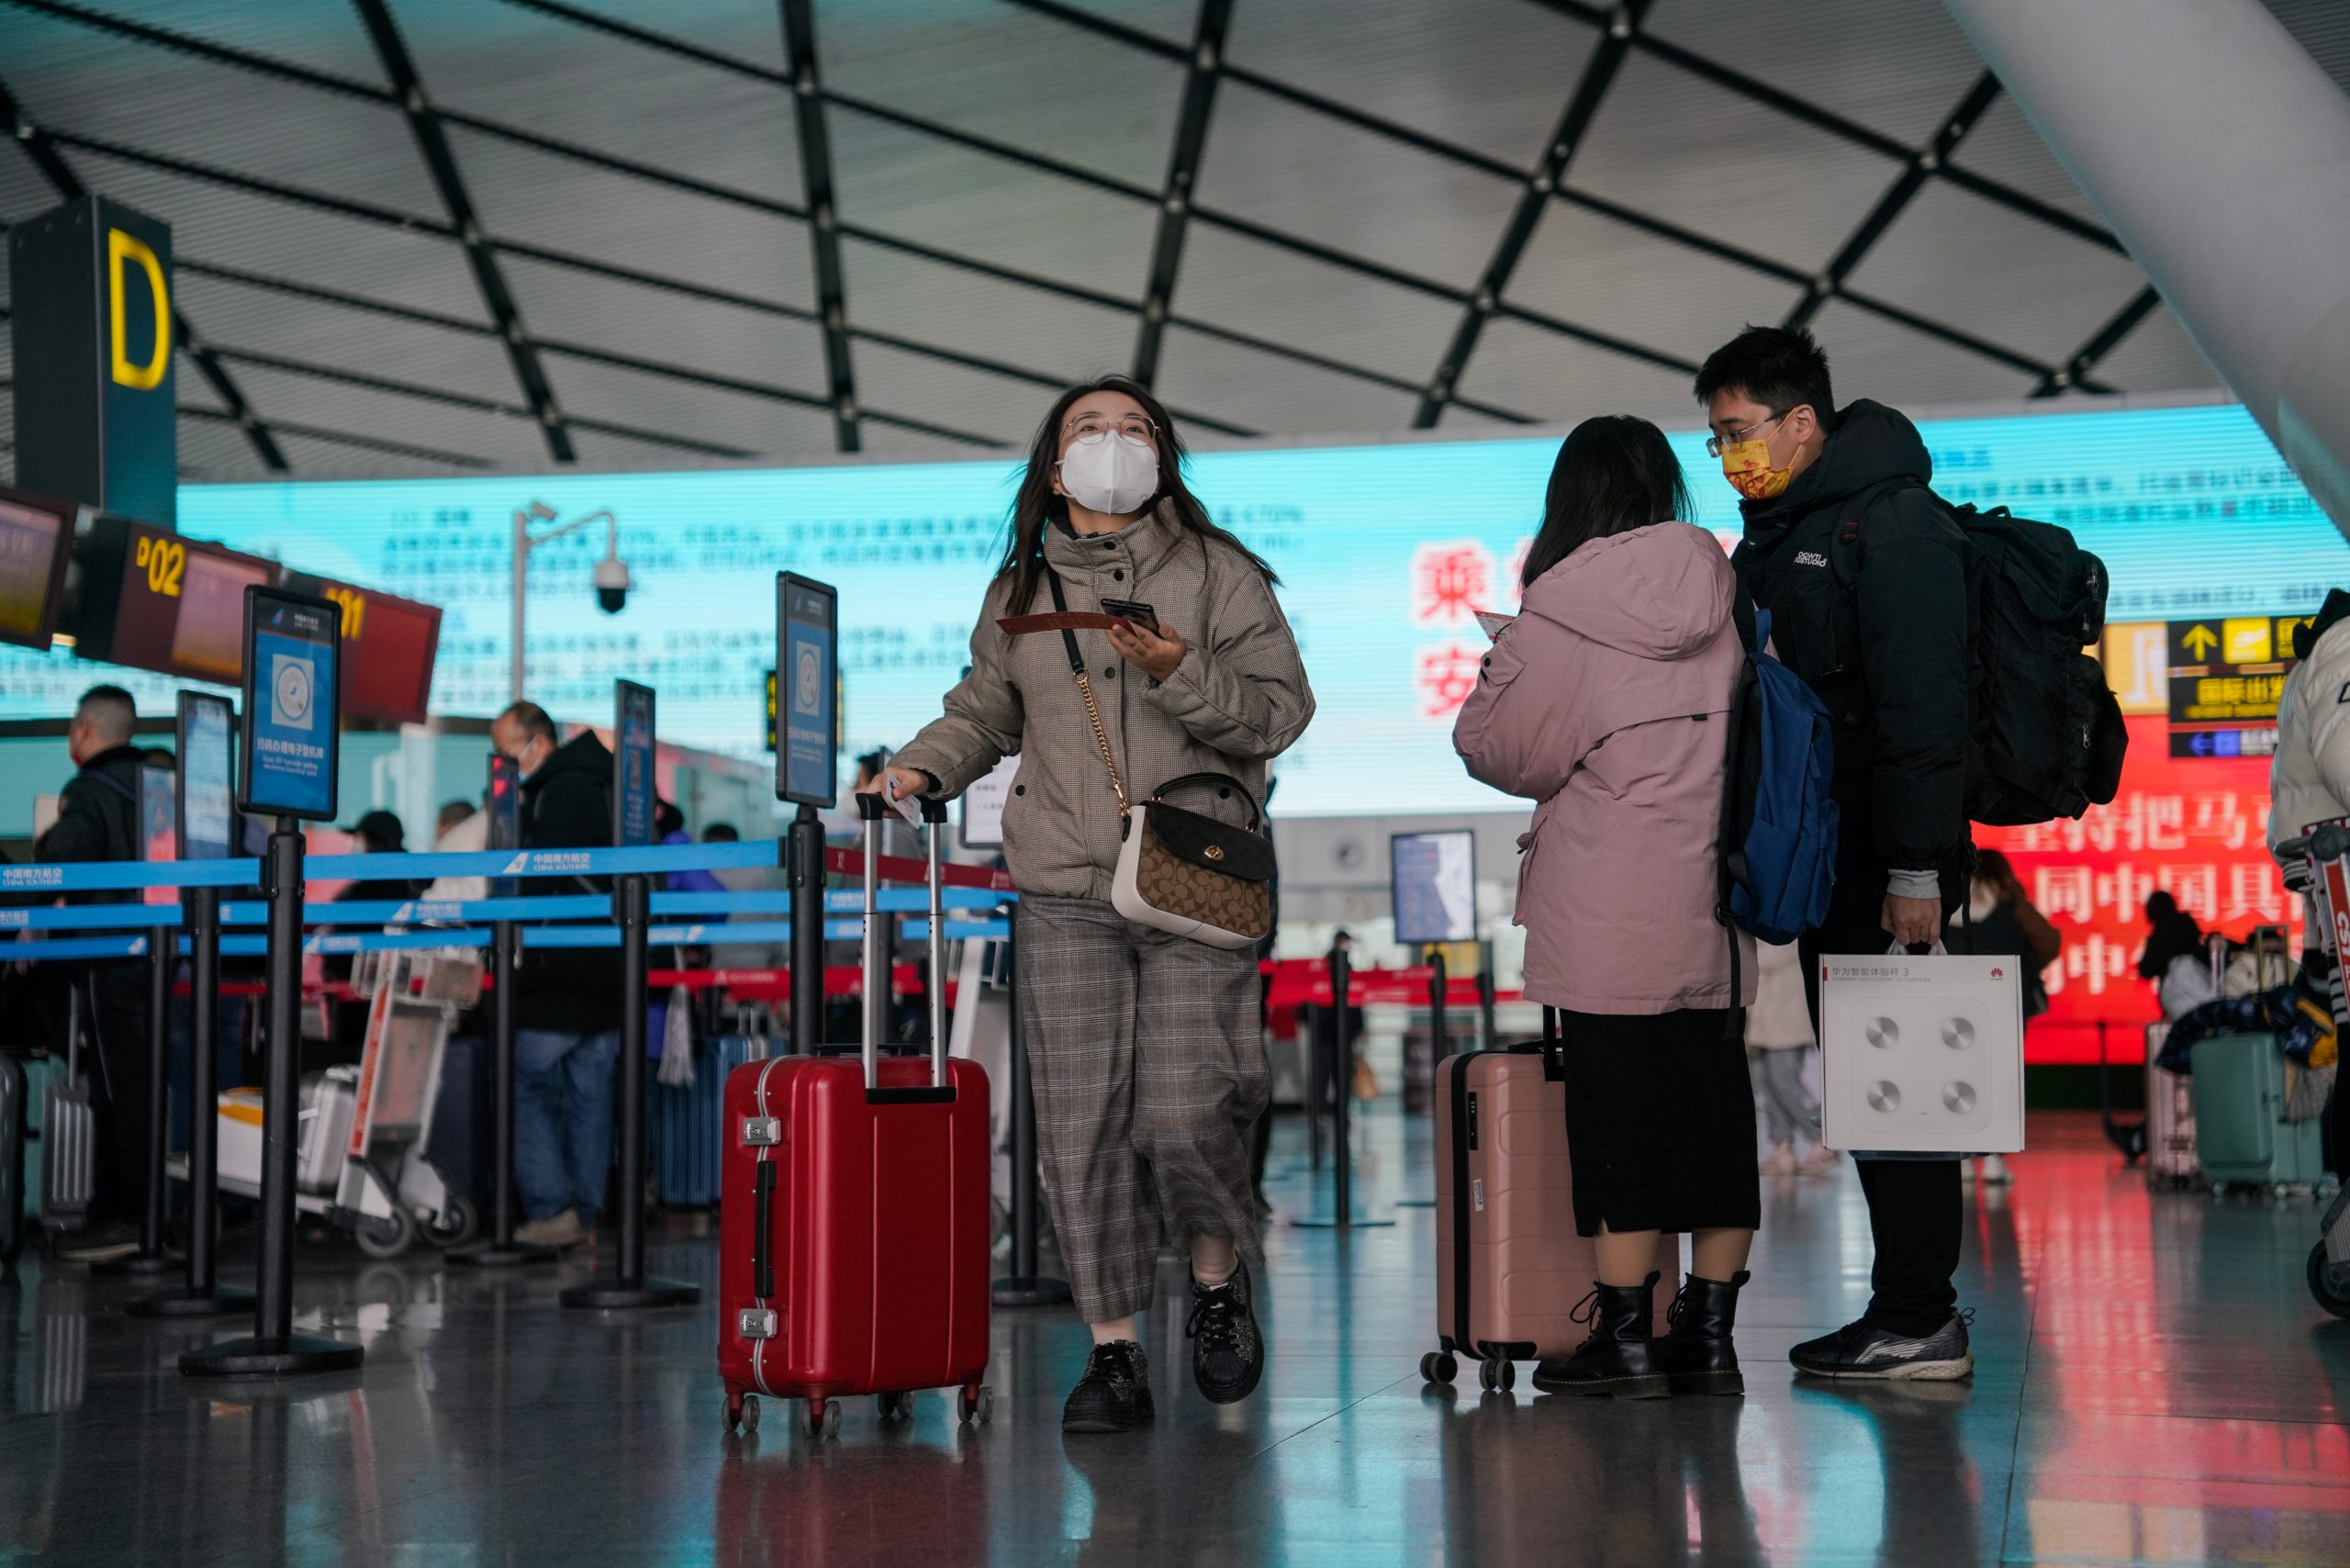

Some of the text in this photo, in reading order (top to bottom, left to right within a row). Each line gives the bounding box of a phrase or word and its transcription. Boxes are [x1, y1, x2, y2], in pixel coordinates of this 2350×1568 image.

[109, 228, 170, 390] D
[325, 587, 366, 642] 01
[533, 852, 590, 864] 中国南方航空
[3, 867, 62, 879] 中国南方航空
[533, 862, 590, 872] CHINA SOUTHERN
[3, 878, 62, 887] CHINA SOUTHERN
[1903, 968, 1909, 977] 3
